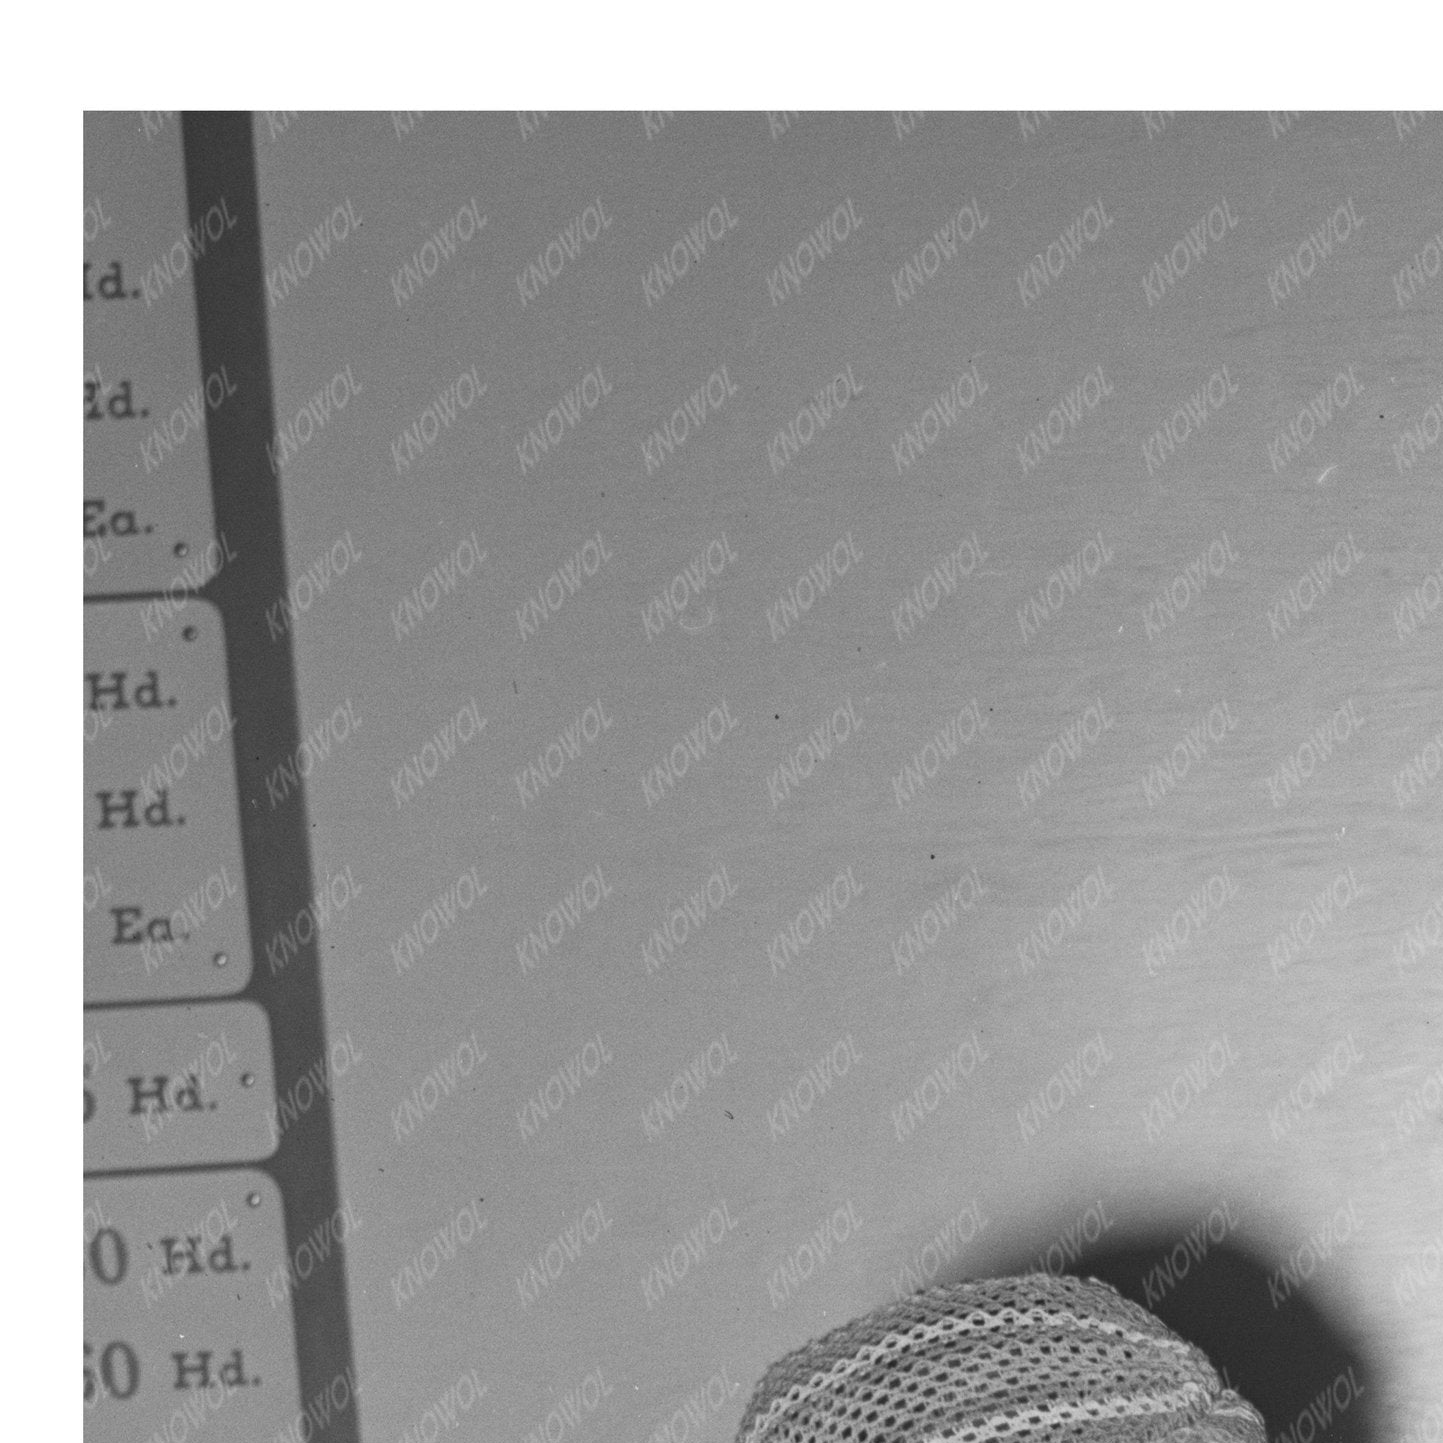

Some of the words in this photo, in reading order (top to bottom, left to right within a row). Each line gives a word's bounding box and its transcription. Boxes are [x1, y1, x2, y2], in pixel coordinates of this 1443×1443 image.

[83, 261, 142, 300] d.
[84, 671, 178, 711] Hd.
[95, 789, 187, 829] Hd.
[110, 906, 191, 946] Ea.
[126, 1074, 218, 1116] Hd.
[160, 1234, 252, 1276] Hd.
[171, 1349, 263, 1390] Hd.
